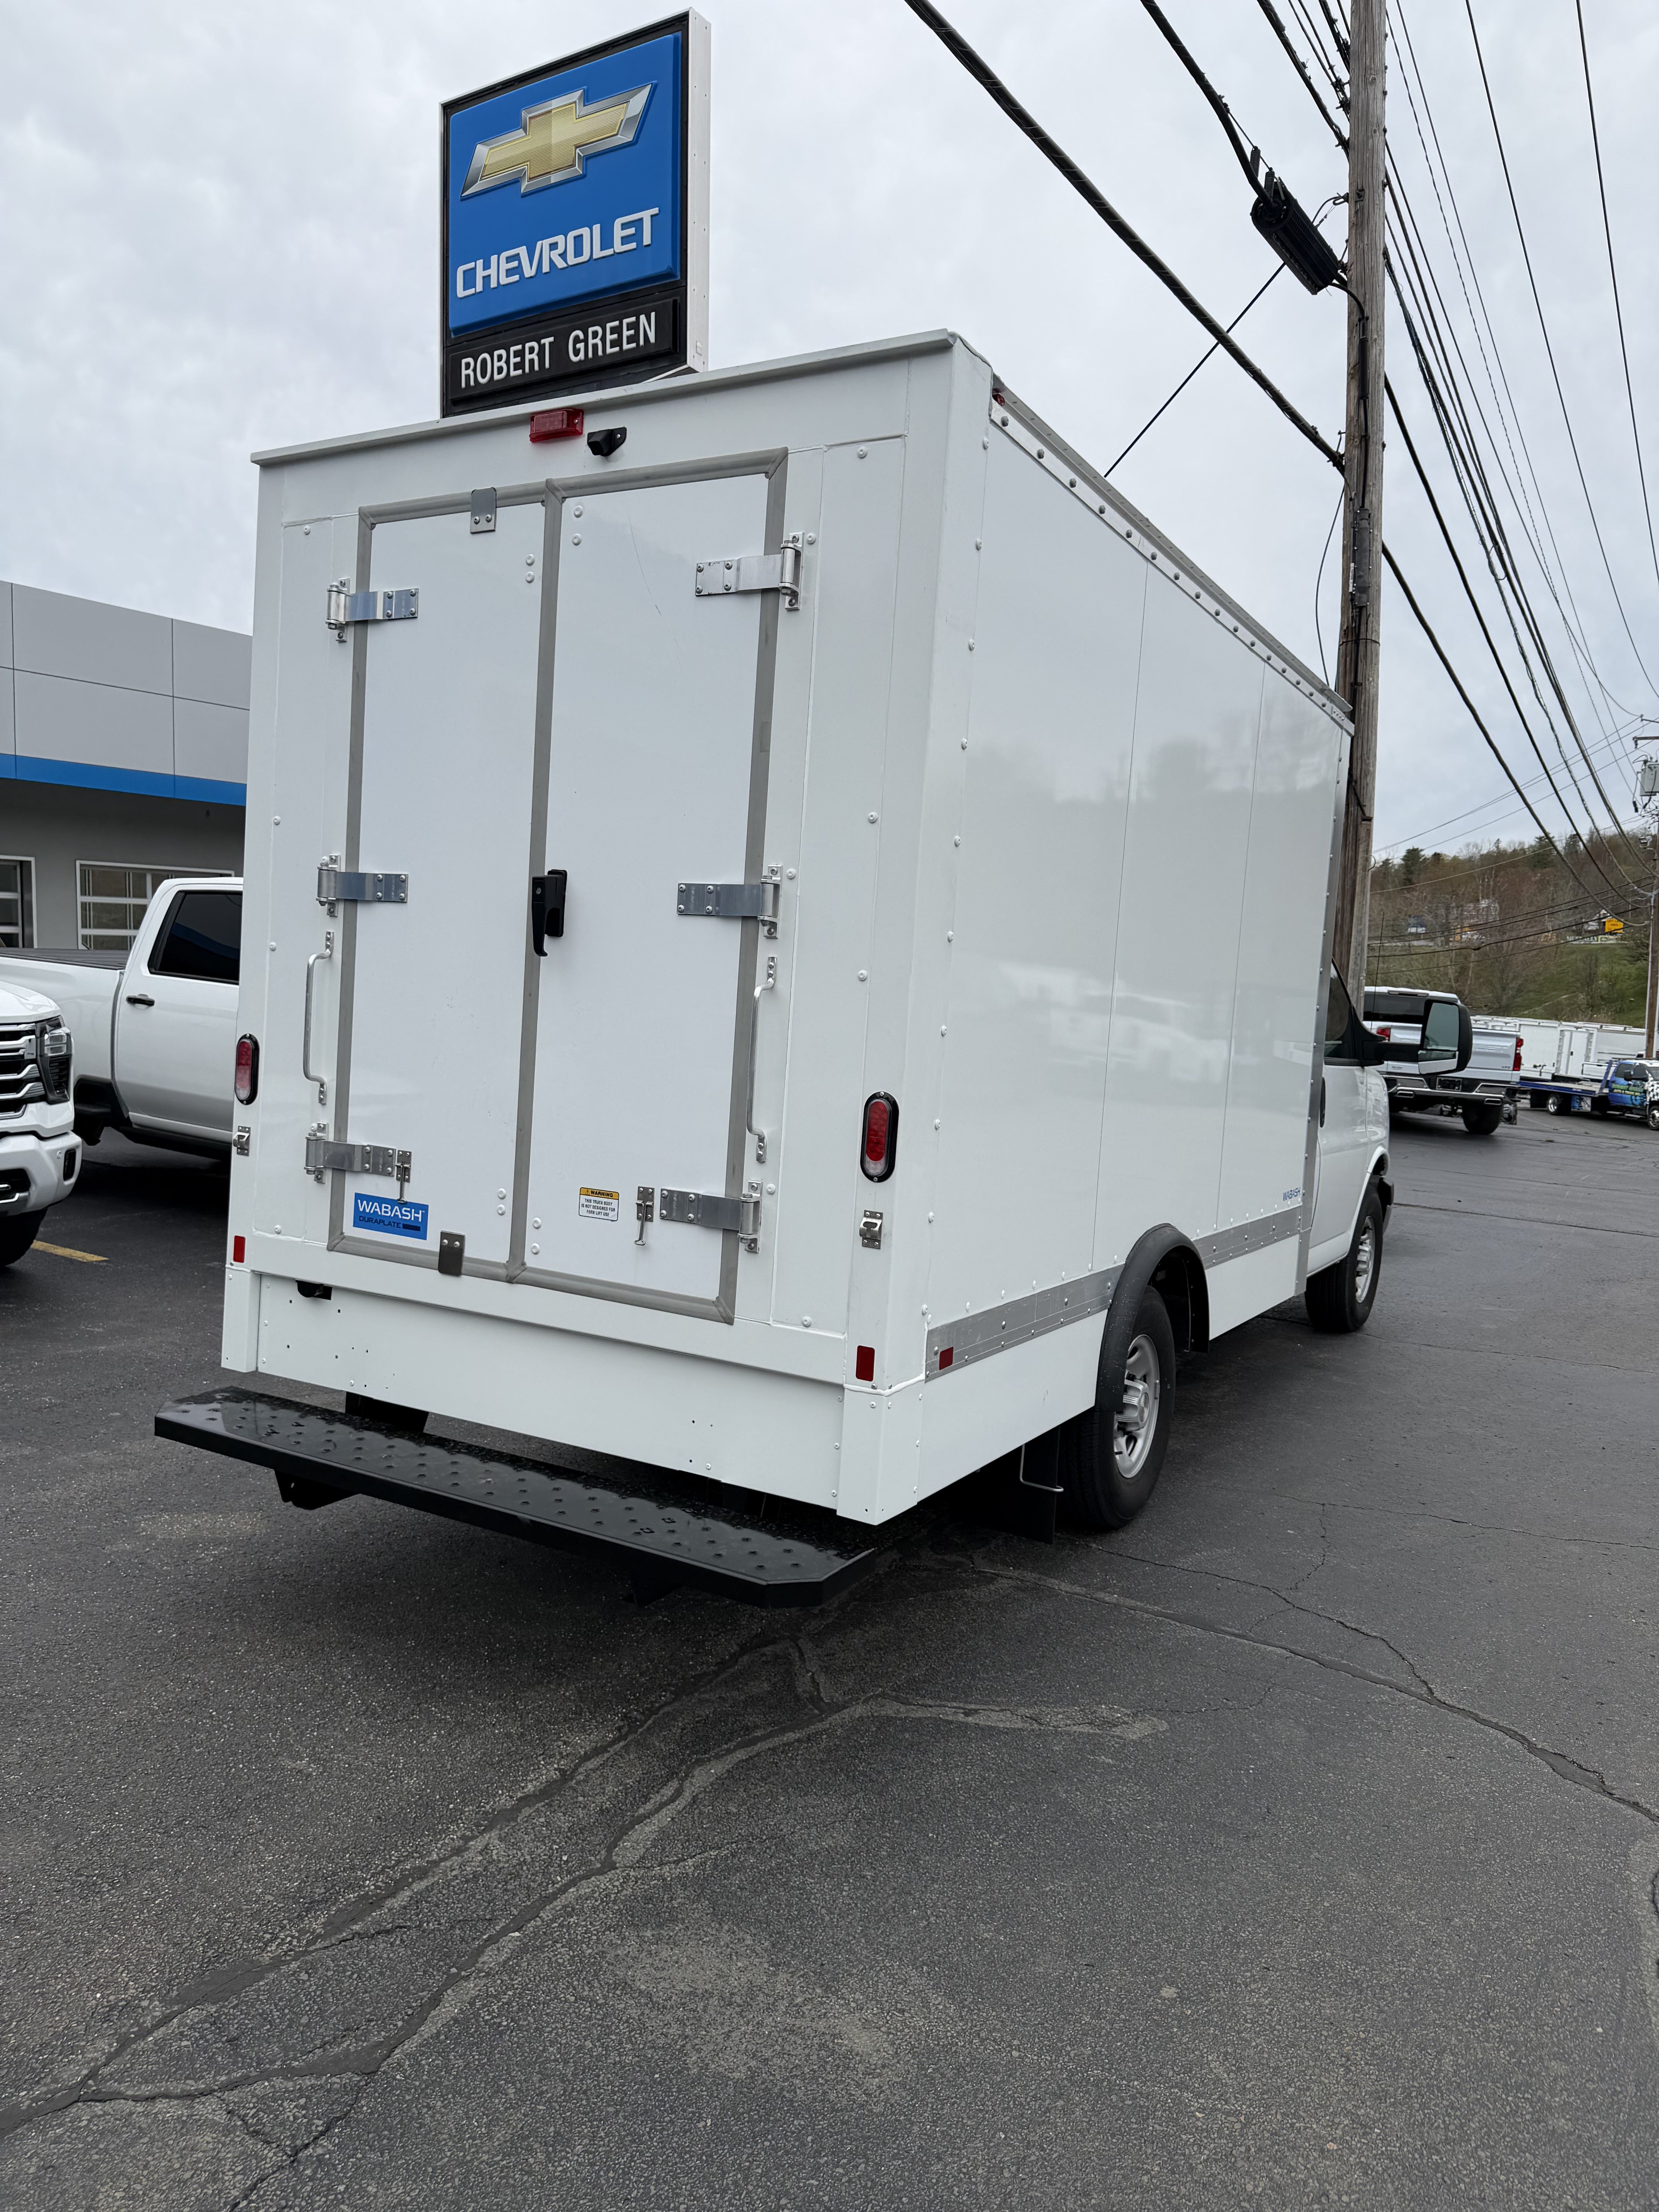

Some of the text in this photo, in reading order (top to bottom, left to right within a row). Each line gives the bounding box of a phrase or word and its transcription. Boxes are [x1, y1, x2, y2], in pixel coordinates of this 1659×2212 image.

[457, 207, 659, 299] CHEVROLET
[460, 311, 657, 388] ROBERT GREEN
[359, 1216, 401, 1228] DURAPLATE
